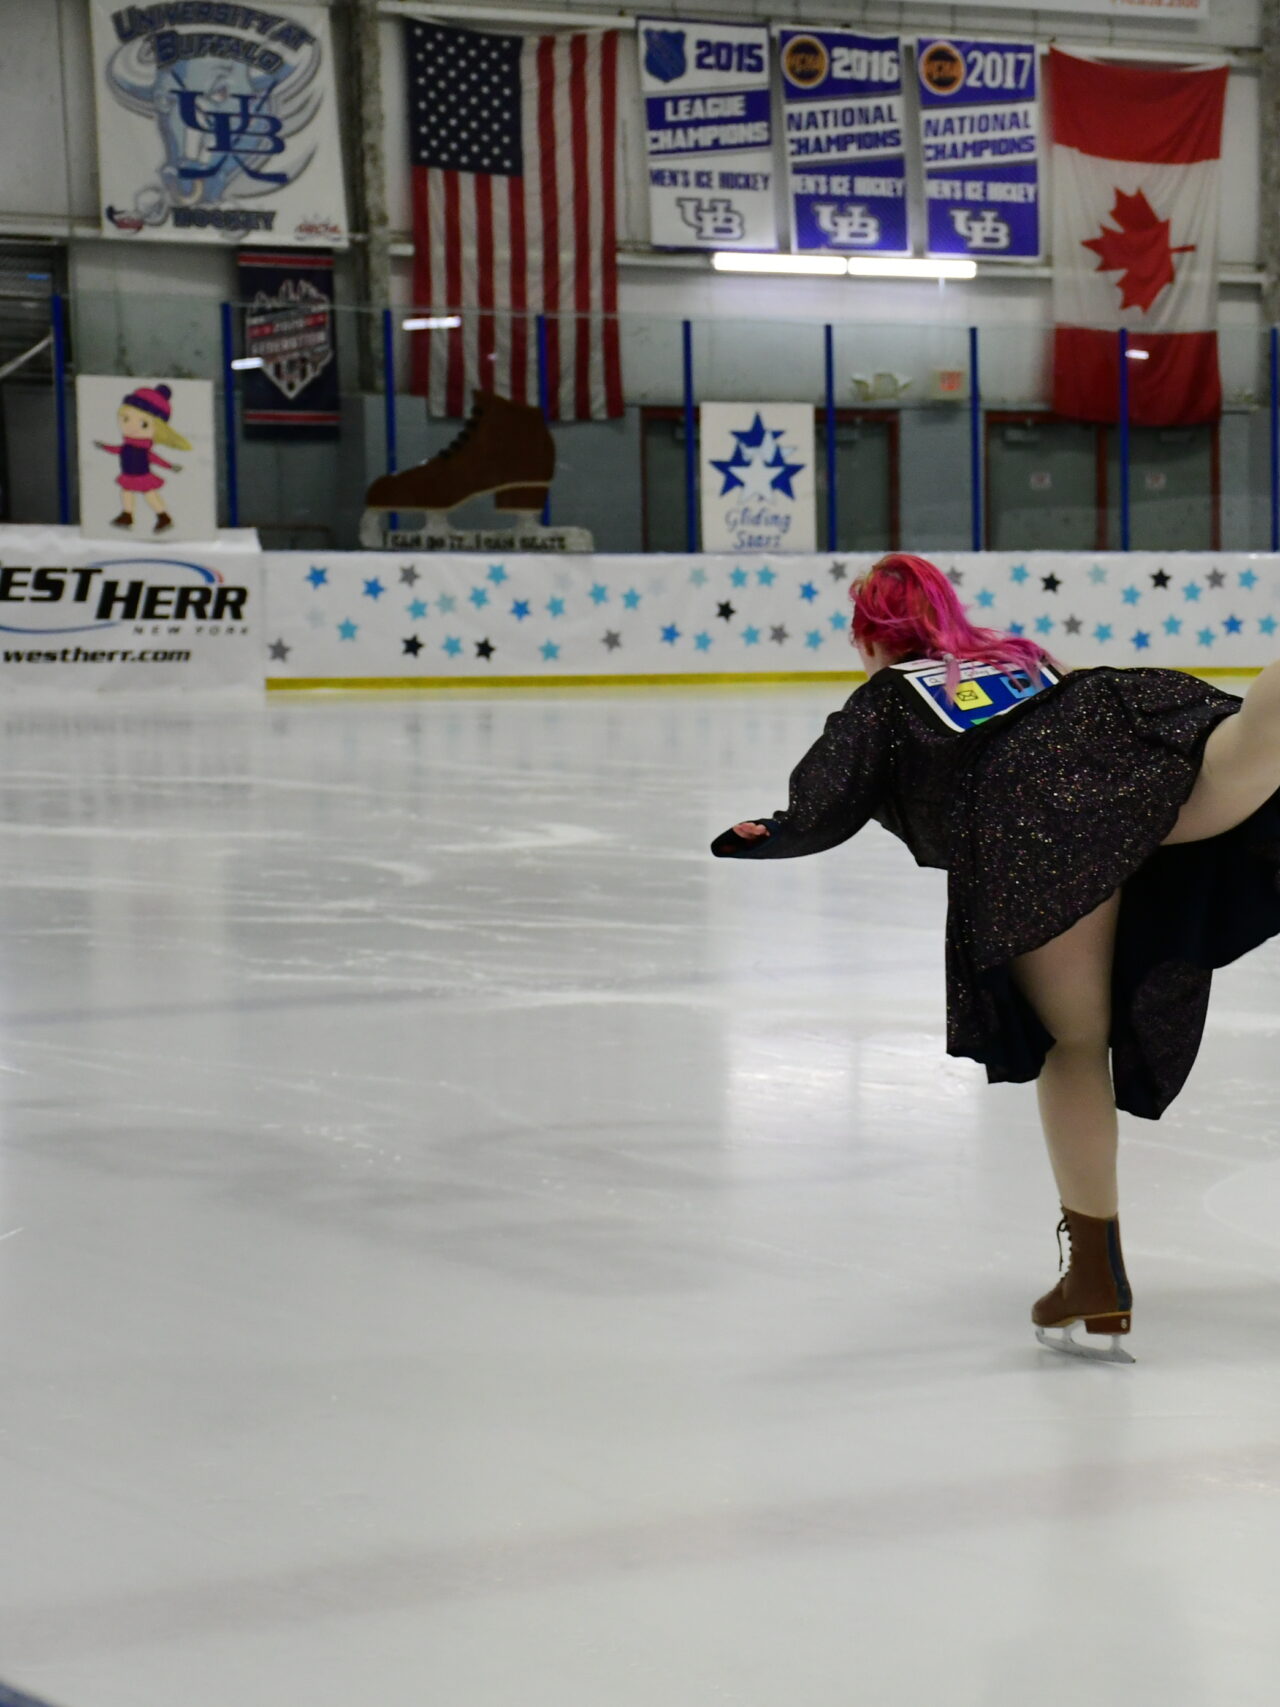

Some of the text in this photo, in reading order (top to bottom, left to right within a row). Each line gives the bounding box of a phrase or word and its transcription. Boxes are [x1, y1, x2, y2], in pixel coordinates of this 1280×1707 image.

[111, 1, 286, 42] UNIVERSITY
[154, 30, 284, 74] BUFFALO
[695, 40, 764, 73] 2015
[830, 46, 900, 83] 2016
[965, 50, 1033, 89] 2017
[665, 95, 746, 122] LEAGUE
[788, 104, 897, 132] NATIONAL
[648, 121, 771, 154] CHAMPIONS
[923, 111, 1031, 138] NATIONAL
[788, 129, 902, 155] CHAMPIONS
[923, 136, 1036, 162] CHAMPIONS
[650, 167, 771, 192] MEN'S ICE HOCKEY
[792, 174, 905, 198] MEN'S ICE HOCKEY
[925, 178, 1036, 203] MEN'S ICE HOCKEY
[172, 208, 276, 232] HOCKEY
[676, 197, 744, 241] UB
[813, 202, 881, 246] UB
[949, 208, 1011, 250] UB
[0, 566, 248, 620] EST HERR
[133, 626, 249, 636] NEW YORK
[3, 647, 191, 664] westherr.com
